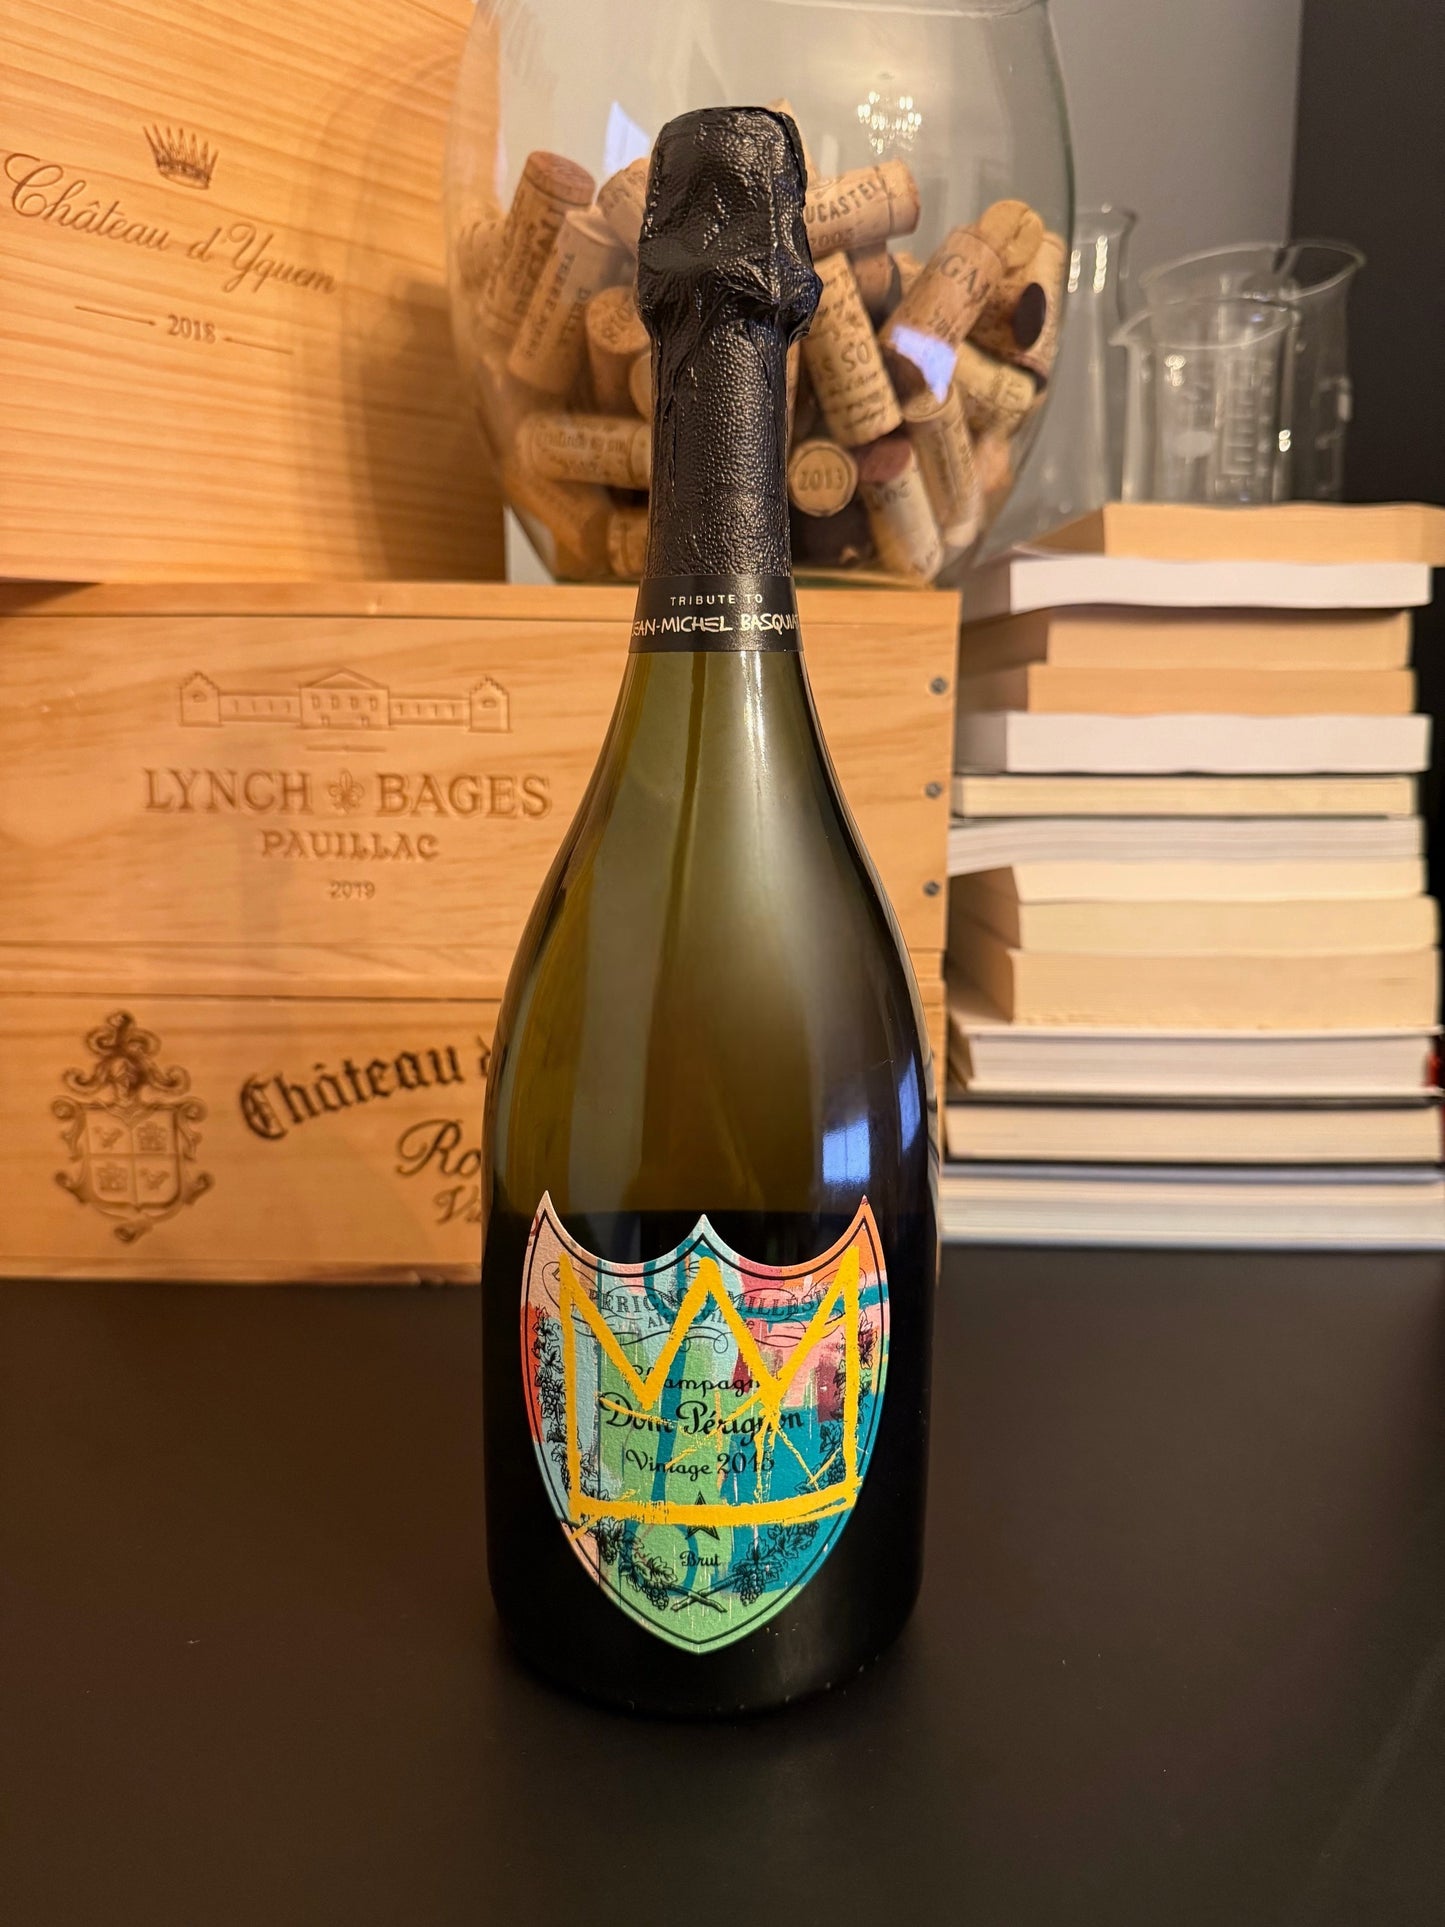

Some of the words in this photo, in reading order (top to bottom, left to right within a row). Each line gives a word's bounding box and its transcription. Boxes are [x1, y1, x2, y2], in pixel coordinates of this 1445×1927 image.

[4, 153, 168, 251] Château
[803, 181, 879, 223] UCASTEL
[167, 313, 217, 345] 2018
[799, 466, 845, 491] 2013
[670, 594, 736, 607] TRIBUTE
[744, 593, 763, 604] TO
[632, 615, 733, 636] EAN-MICHEL
[143, 768, 314, 814] LYNCH
[376, 771, 553, 818] BAGES
[261, 829, 440, 861] PAUILLAC
[329, 880, 376, 900] 2019
[238, 1045, 466, 1141] Château
[625, 1449, 712, 1482] Vintage
[679, 1549, 722, 1568] Brut
